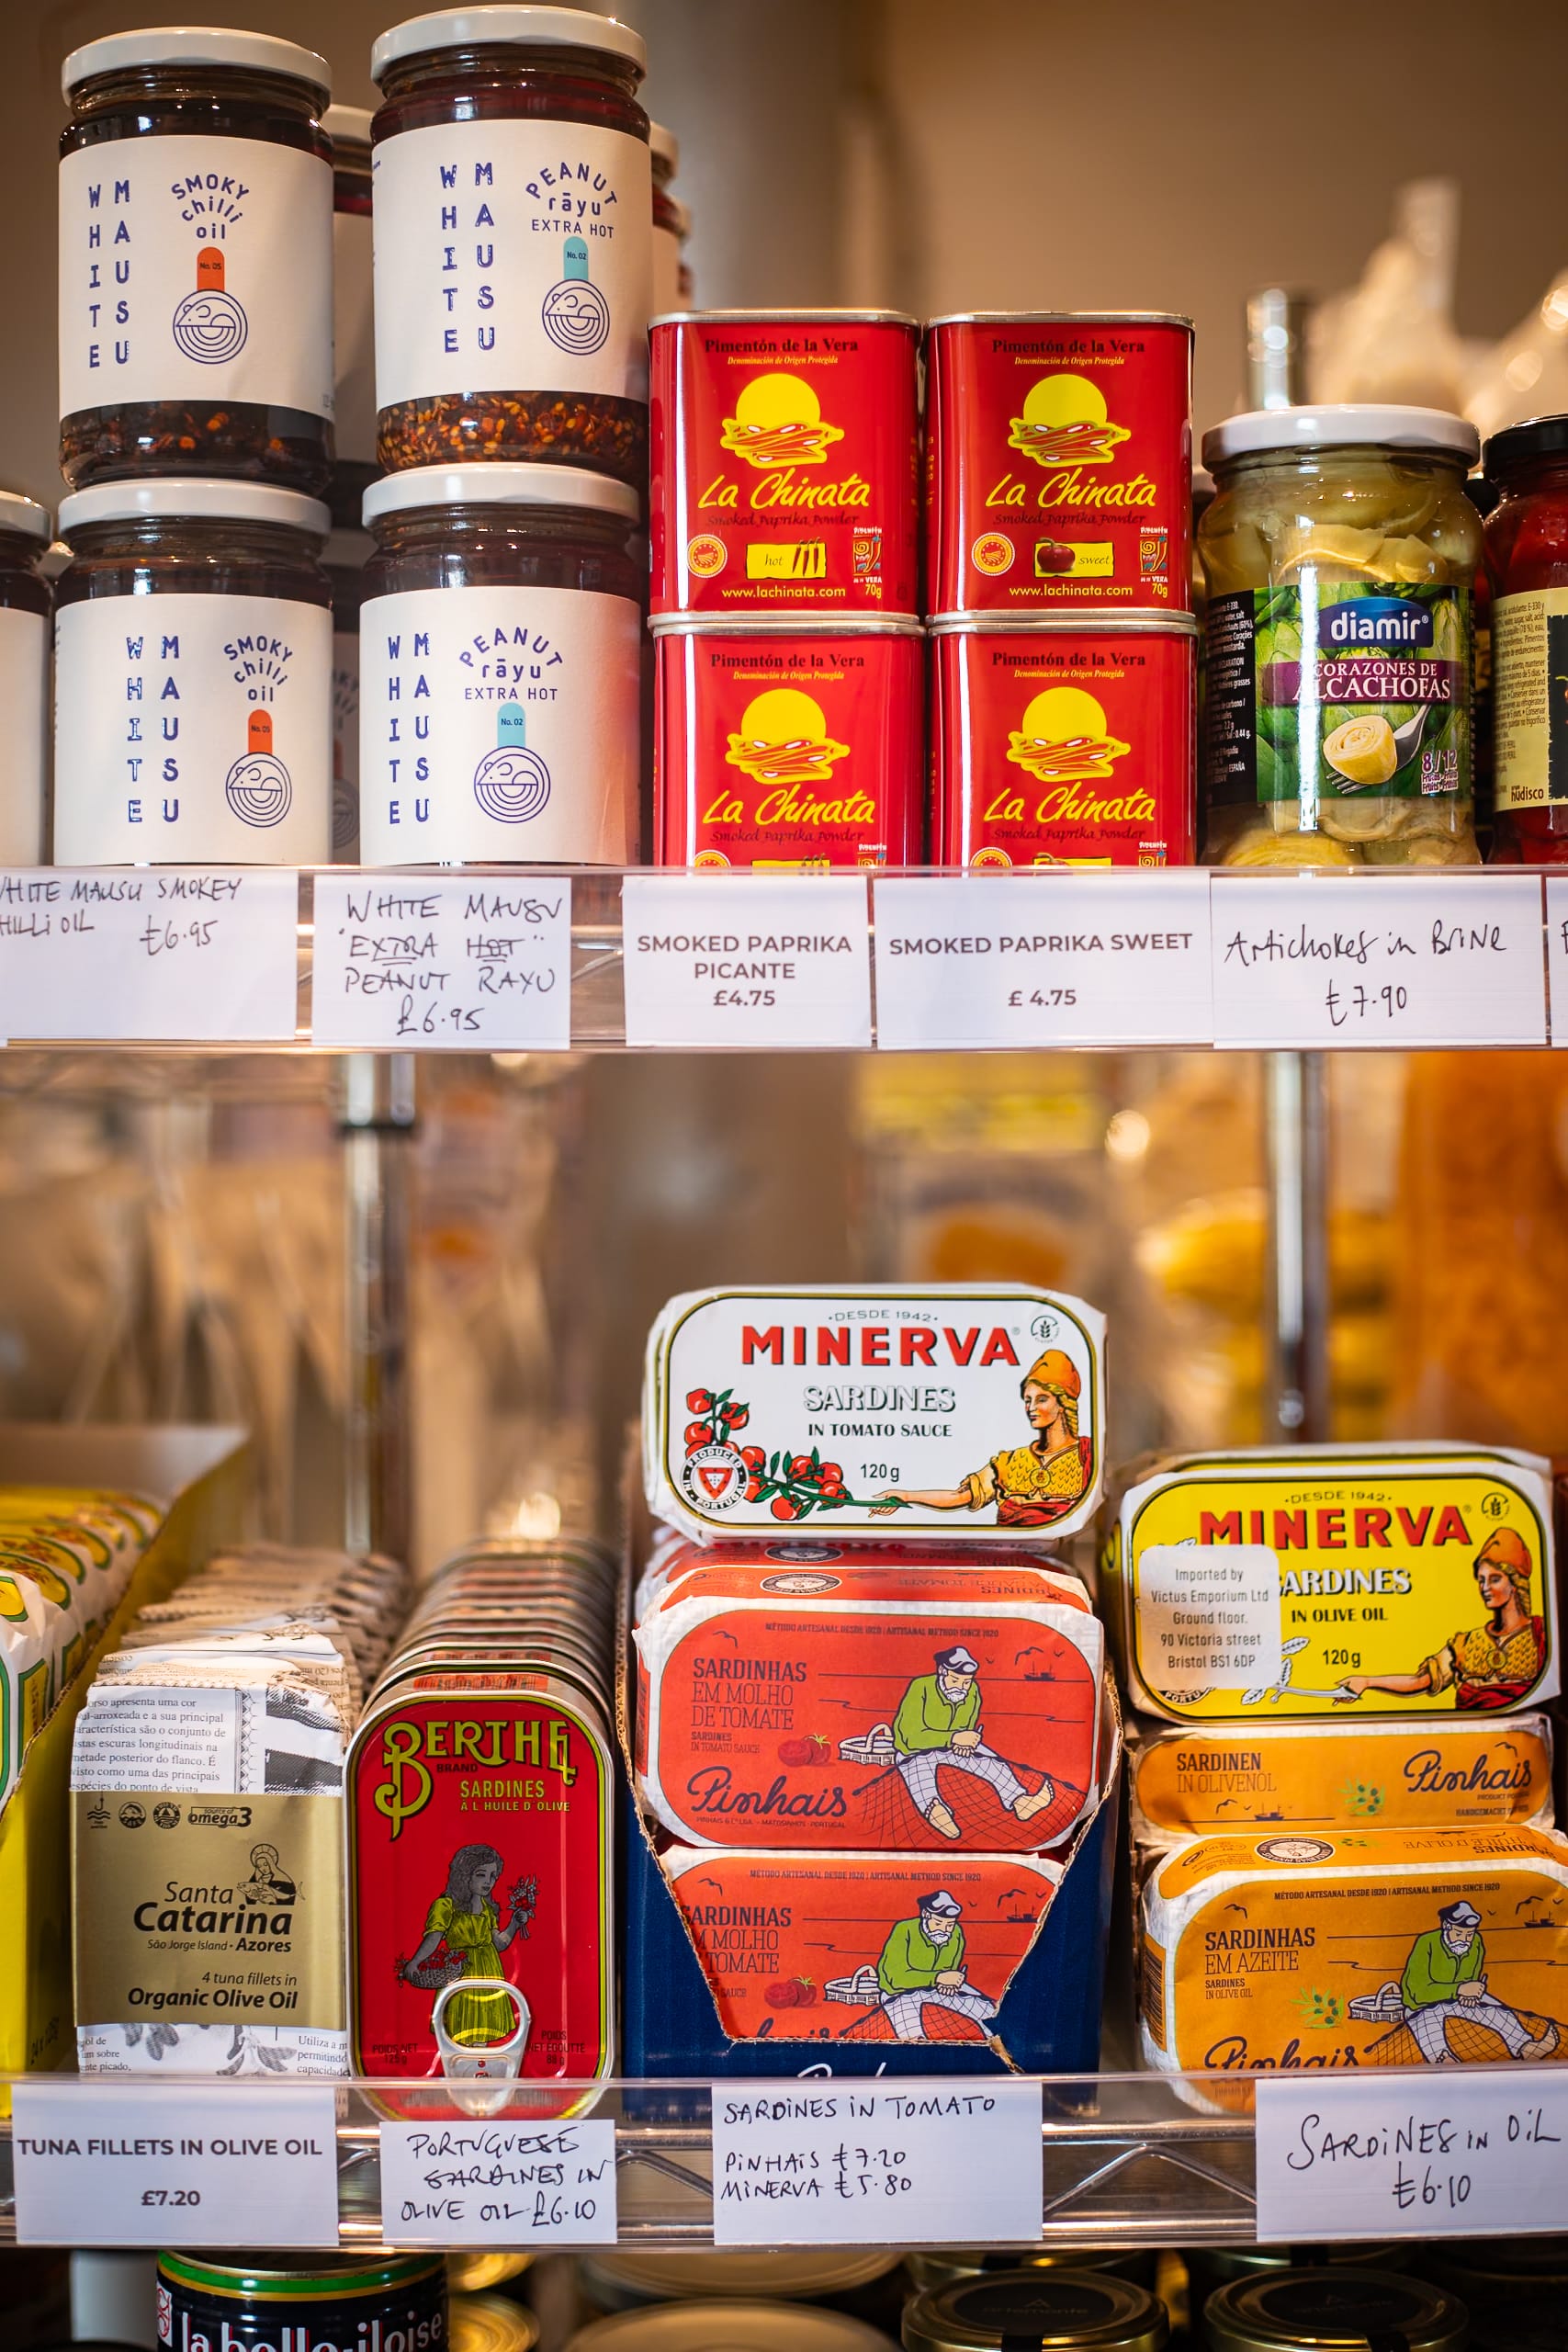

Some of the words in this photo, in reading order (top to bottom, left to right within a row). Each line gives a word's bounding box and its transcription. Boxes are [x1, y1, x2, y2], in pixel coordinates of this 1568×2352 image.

[171, 174, 250, 200] SMOKY
[525, 162, 617, 208] PEANUT
[182, 196, 243, 223] chilli
[196, 223, 226, 239] oil
[531, 219, 582, 234] EXTRA
[590, 224, 615, 239] HOT
[705, 338, 777, 353] Pimentón
[782, 338, 799, 352] de
[804, 338, 818, 352] la
[823, 338, 859, 352] Vera
[698, 475, 739, 509] La
[750, 468, 872, 510] Chinata
[986, 474, 1025, 507] La
[1038, 467, 1156, 508] Chinata
[764, 554, 784, 567] hot
[1078, 554, 1110, 565] sweet
[722, 585, 846, 598] www.lachinata.com
[865, 584, 882, 599] 70g
[1010, 584, 1133, 597] www.lachinata.com
[1331, 612, 1421, 641] diamir
[459, 627, 563, 668] PEANUT
[992, 652, 1065, 666] Pimentón
[1069, 652, 1088, 666] de
[1091, 652, 1105, 665] la
[1110, 652, 1145, 666] Vera
[1314, 662, 1416, 677] CORAZONES
[1421, 663, 1437, 676] DE
[465, 687, 518, 700] EXTRA
[527, 688, 558, 701] HOT
[703, 789, 742, 824] La
[754, 784, 875, 825] Chinata
[158, 876, 242, 900] SMOKEY
[347, 890, 442, 922] WHITE
[140, 915, 218, 956] £6.95
[637, 935, 739, 952] SMOKED
[748, 935, 852, 952] PAPRIKA
[889, 936, 992, 955] SMOKED
[999, 934, 1103, 953] PAPRIKA
[1111, 933, 1192, 950] SWEET
[1224, 924, 1378, 966] Artichokes
[1387, 932, 1416, 956] in
[345, 967, 451, 994] PEANUT
[694, 963, 795, 978] PICANTE
[713, 990, 775, 1006] £4.75
[397, 994, 484, 1035] £6.95
[741, 1325, 1021, 1367] MINERVA
[803, 1385, 956, 1413] SARDINES
[808, 1425, 824, 1437] IN
[829, 1424, 896, 1437] TOMATO
[901, 1425, 953, 1437] SAUCE
[1200, 1506, 1472, 1550] MINERVA
[1176, 1568, 1227, 1581] Imported
[1230, 1568, 1244, 1582] by
[1151, 1590, 1187, 1603] Victus
[1190, 1590, 1247, 1605] Emporium
[1251, 1589, 1269, 1602] Ltd
[1173, 1611, 1213, 1624] Ground
[1292, 1610, 1307, 1623] IN
[1312, 1609, 1357, 1623] OLIVE
[1362, 1608, 1389, 1622] OIL
[1161, 1634, 1174, 1646] 90
[1178, 1633, 1223, 1645] Victoria
[1226, 1634, 1261, 1645] street
[693, 1657, 807, 1682] SARDINHAS
[1168, 1656, 1207, 1668] Bristol
[1211, 1655, 1230, 1668] BS1
[1234, 1655, 1256, 1668] 6DP
[692, 1682, 720, 1704] EM
[726, 1683, 794, 1707] MOLHO
[691, 1703, 716, 1727] DE
[719, 1704, 794, 1730] TOMATE
[98, 1740, 135, 1748] escuras
[139, 1738, 203, 1751] longitudinais
[206, 1744, 218, 1752] na
[109, 1755, 154, 1766] posterior
[156, 1754, 169, 1763] do
[436, 1763, 479, 1773] BRAND
[1177, 1752, 1262, 1772] SARDINEN
[1404, 1749, 1531, 1792] Pinhais
[374, 1719, 577, 1842] BERTHE
[460, 1780, 545, 1798] SARDINES
[687, 1765, 847, 1817] Pinhais
[164, 1882, 233, 1905] Santa
[1348, 1889, 1370, 1897] DESDE
[134, 1902, 293, 1935] Catarina
[147, 1939, 167, 1950] São
[167, 1939, 196, 1952] Jorge
[197, 1939, 228, 1951] Island
[235, 1938, 292, 1953] Azores
[1205, 1927, 1315, 1951] SARDINHAS
[1205, 1953, 1233, 1975] EM
[1235, 1950, 1299, 1973] AZEITE
[202, 1973, 210, 1984] 4
[213, 1973, 244, 1984] tuna
[247, 1972, 282, 1986] fillets
[285, 1974, 297, 1986] in
[1205, 1977, 1246, 1989] SARDINES
[128, 1987, 209, 2009] Organic
[212, 1988, 265, 2008] Olive
[269, 1991, 299, 2009] Oil
[1205, 1990, 1214, 1999] IN
[1215, 1988, 1239, 1999] OLIVE
[1240, 1987, 1254, 1998] OIL
[886, 2095, 996, 2120] TOMATO
[17, 2139, 81, 2155] TUNA
[88, 2139, 174, 2155] FILLETS
[181, 2139, 203, 2155] IN
[210, 2139, 277, 2155] OLIVE
[285, 2139, 322, 2155] OIL
[407, 2126, 580, 2158] PORTUGUESE
[424, 2164, 563, 2189] SARDINES
[578, 2160, 613, 2184] IN
[1393, 2161, 1471, 2209] £6.10
[141, 2190, 201, 2206] £7.20
[401, 2199, 464, 2222] OLIVE
